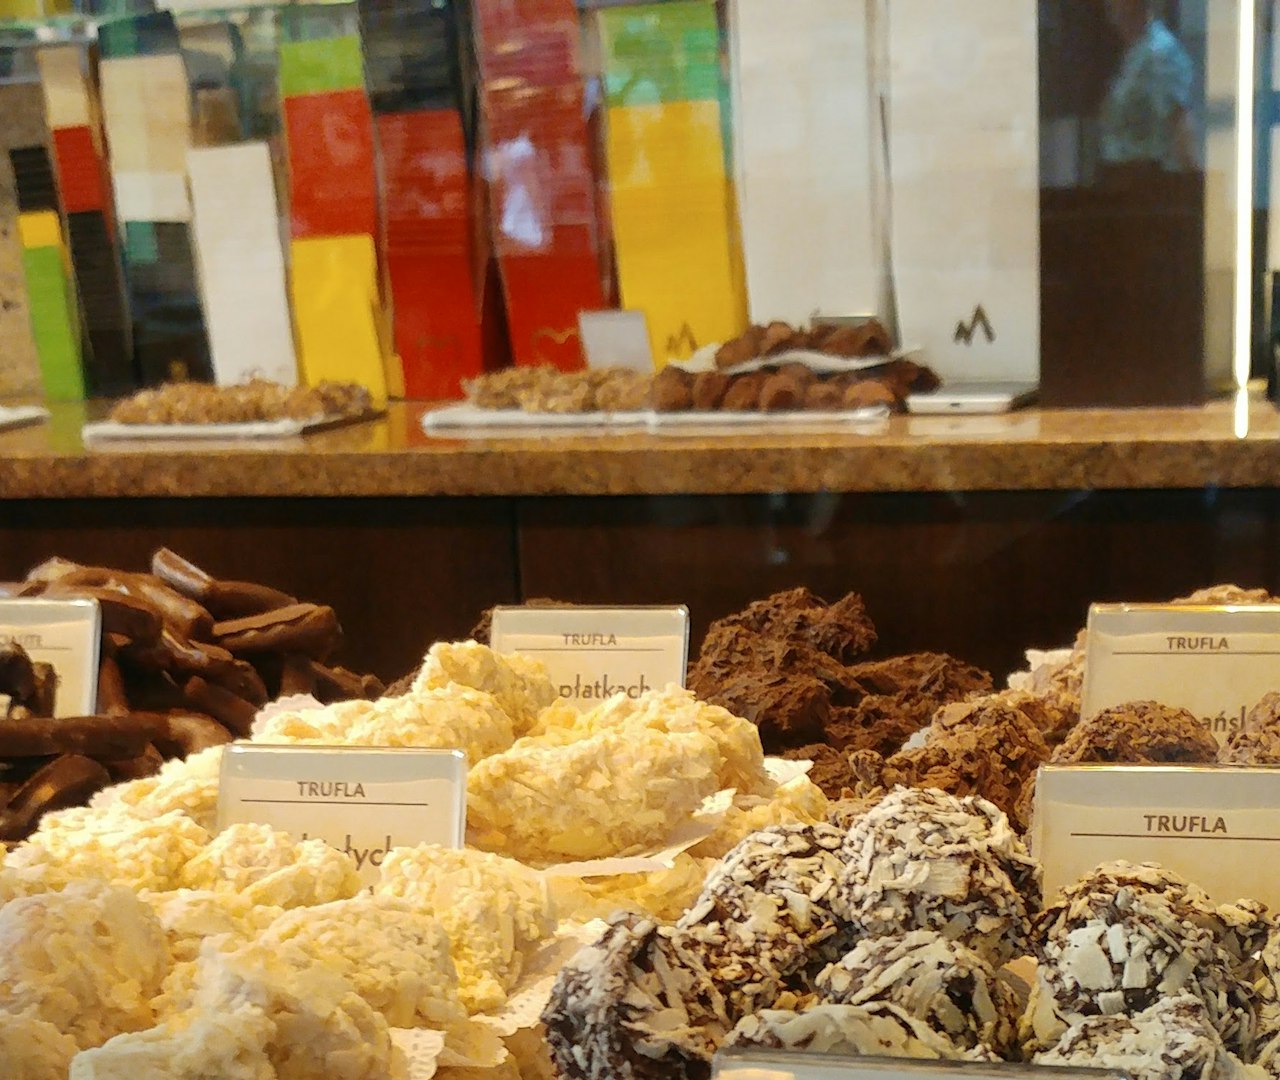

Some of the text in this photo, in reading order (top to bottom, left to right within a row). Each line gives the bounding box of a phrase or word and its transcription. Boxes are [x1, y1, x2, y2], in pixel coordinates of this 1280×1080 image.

[562, 633, 617, 646] TRUFLA
[1166, 636, 1230, 650] TRUFLA
[297, 781, 366, 798] TRUFLA
[1144, 814, 1228, 833] TRUFLA
